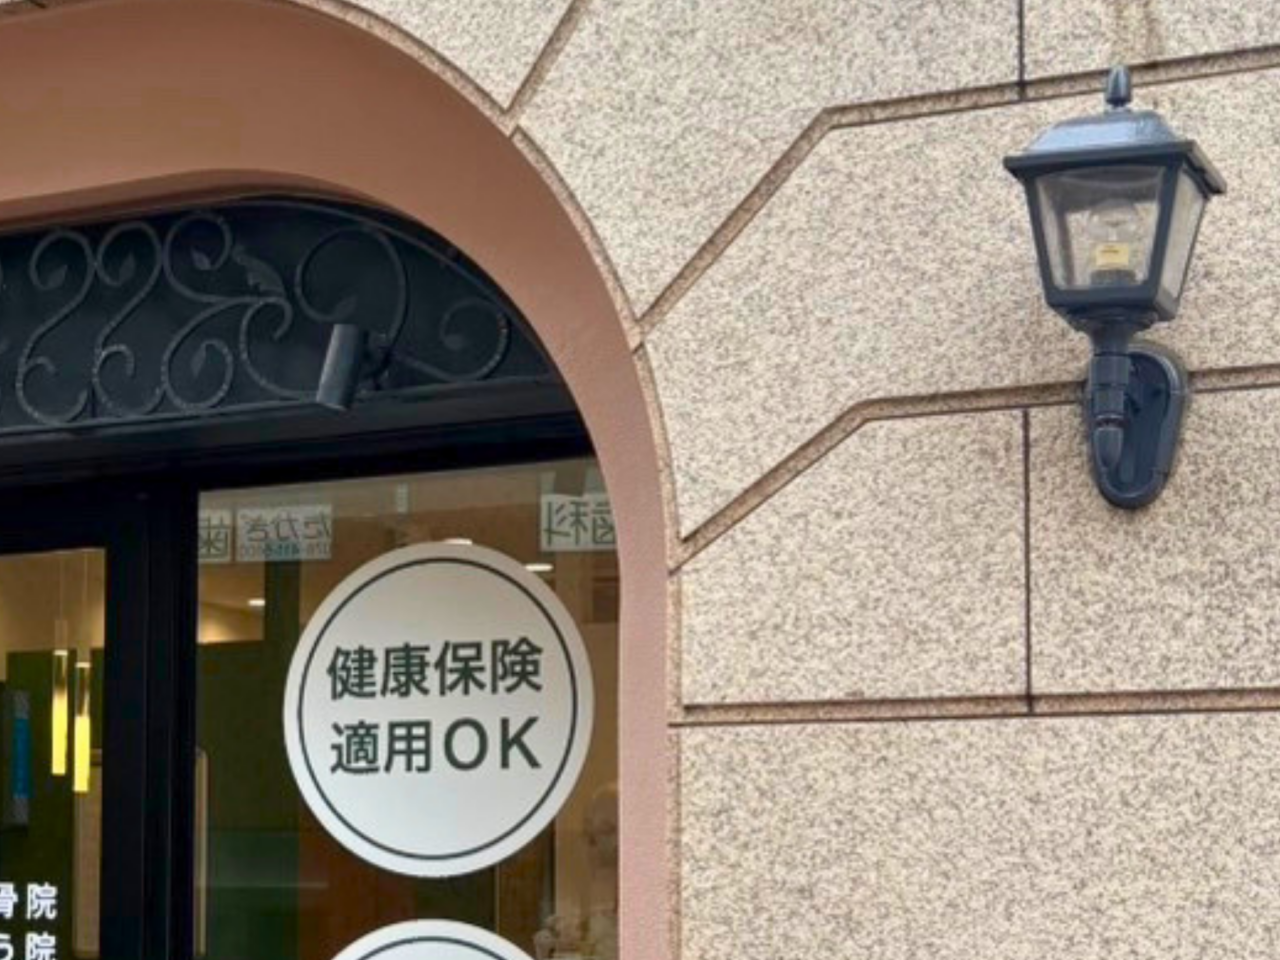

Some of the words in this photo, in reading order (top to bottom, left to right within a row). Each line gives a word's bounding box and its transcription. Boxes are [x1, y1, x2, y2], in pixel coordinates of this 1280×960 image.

[327, 637, 543, 700] 健康保険
[330, 716, 541, 774] 適用OK
